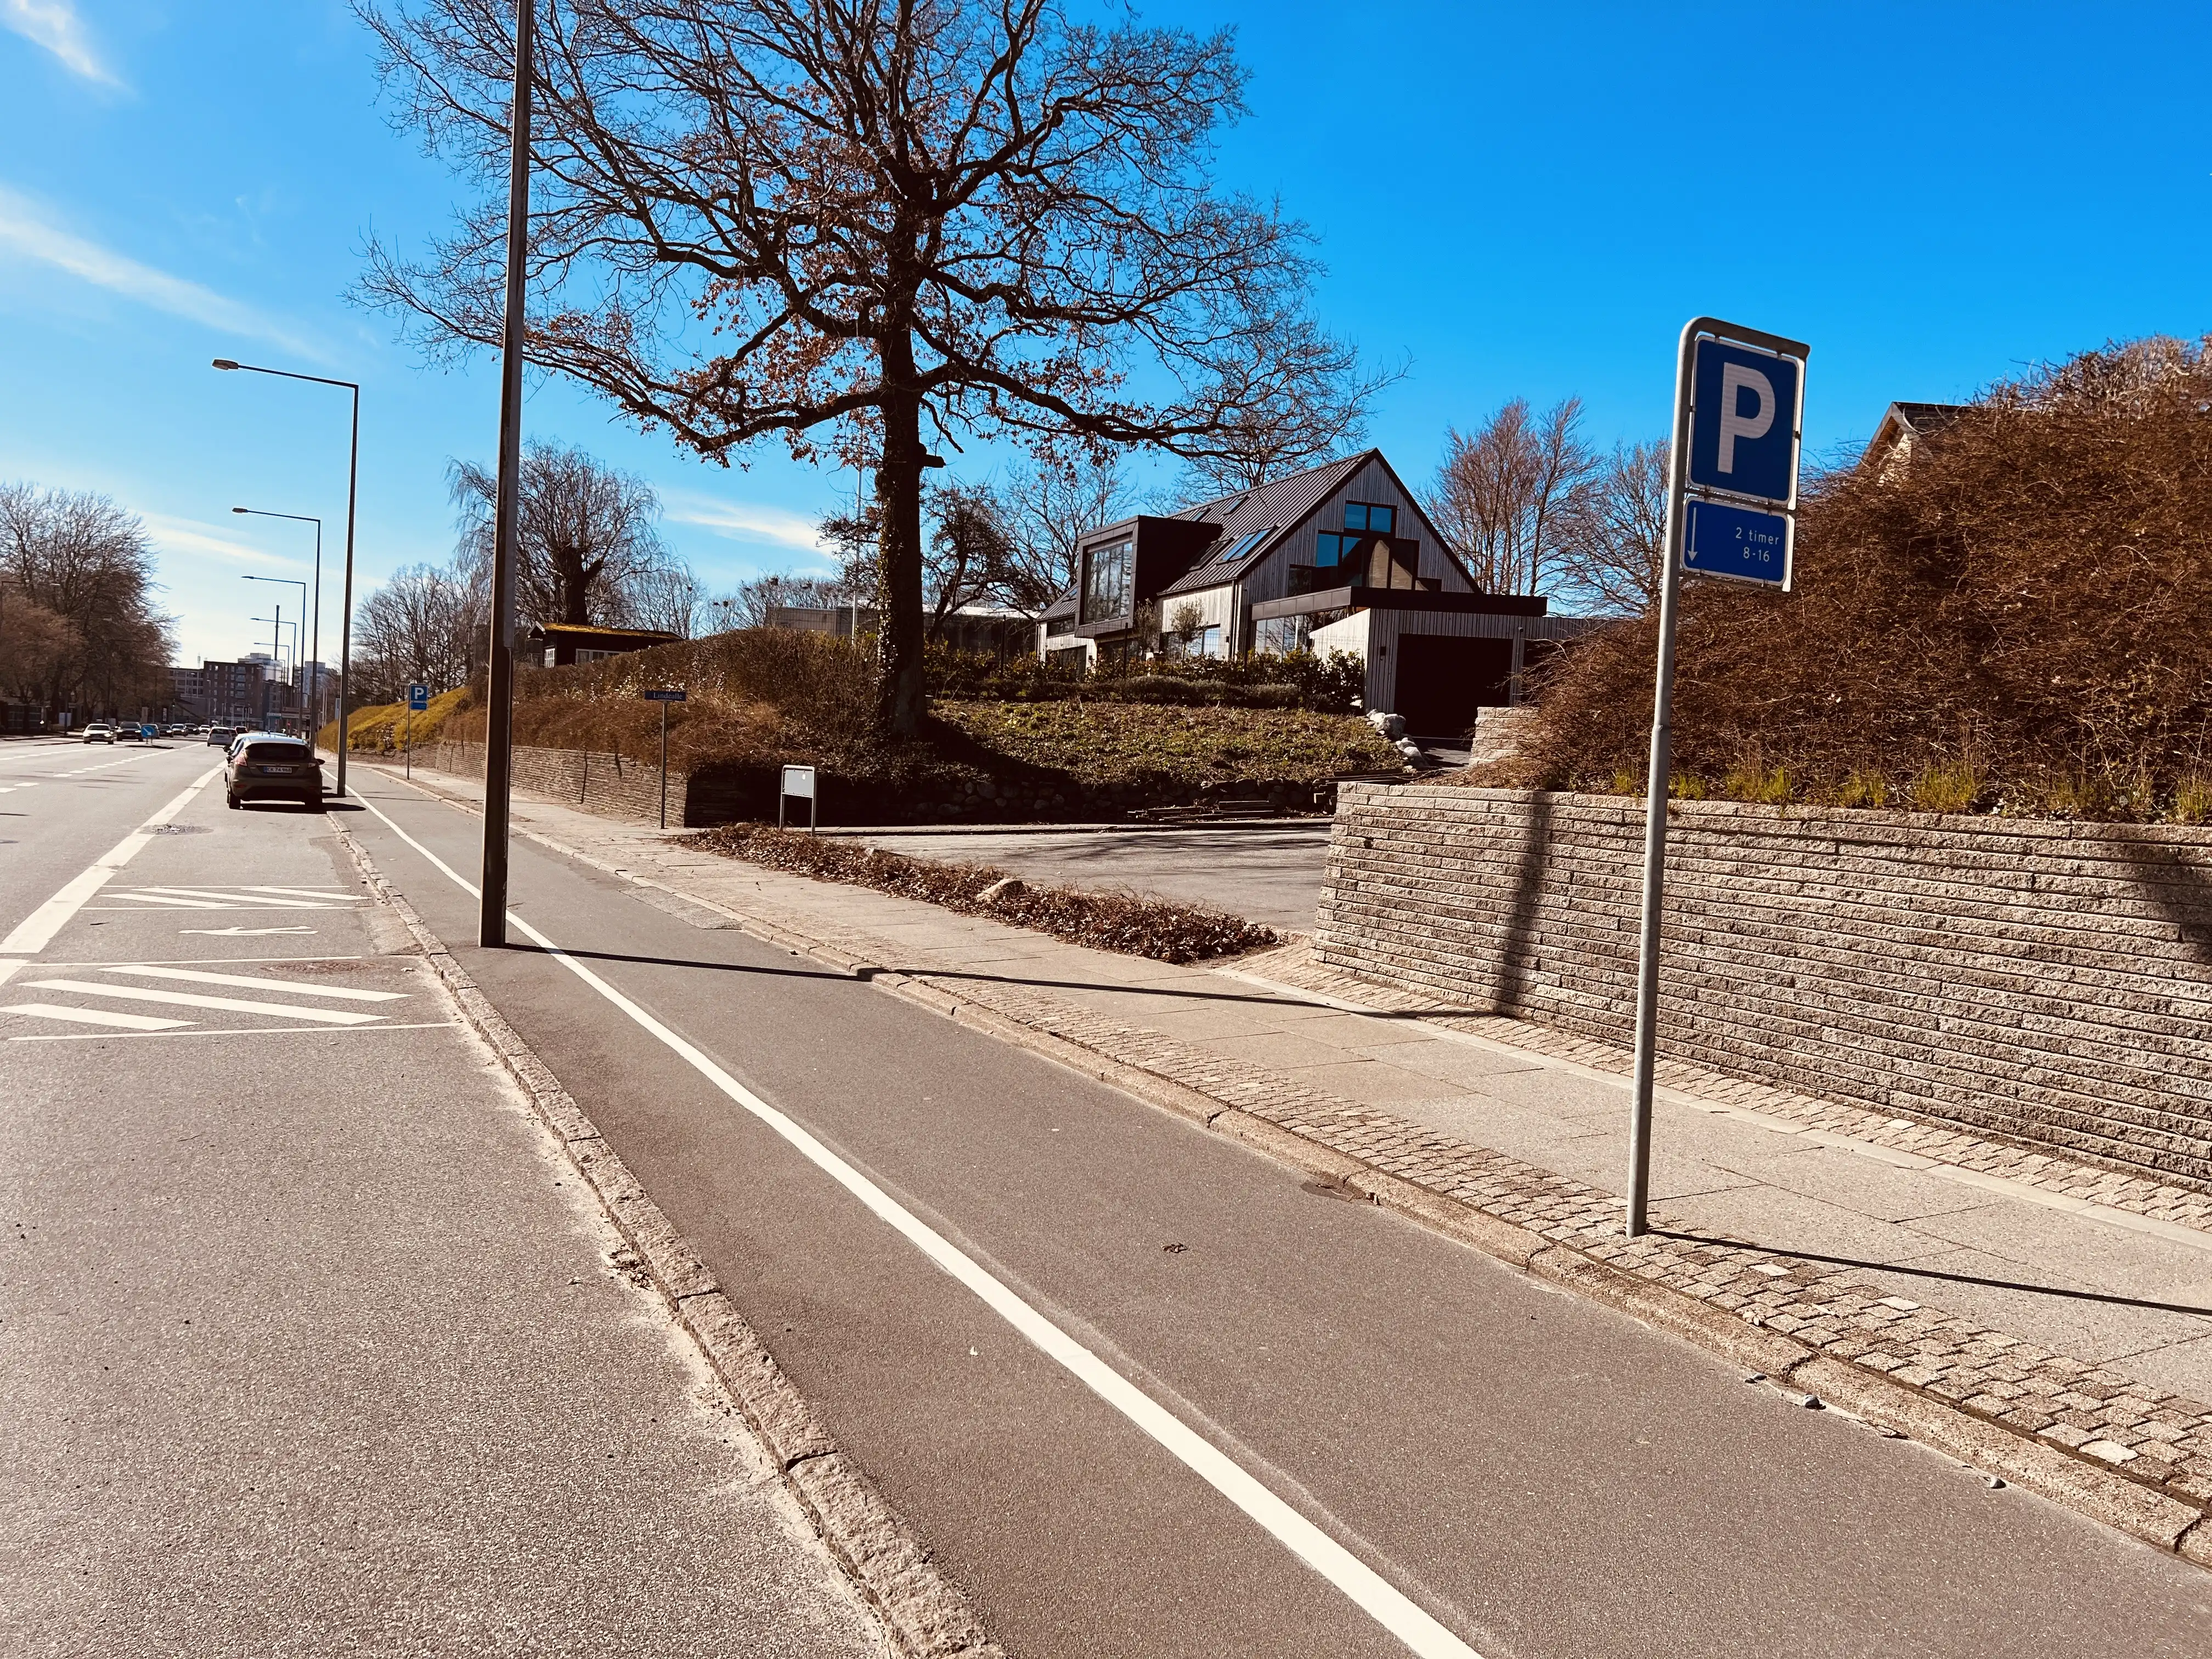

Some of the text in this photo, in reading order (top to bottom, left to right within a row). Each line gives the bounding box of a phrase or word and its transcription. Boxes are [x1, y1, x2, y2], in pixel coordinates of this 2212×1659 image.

[1718, 362, 1775, 473] P
[1736, 527, 1779, 545] 2 timer
[1743, 546, 1770, 562] 8-16
[415, 687, 424, 699] P
